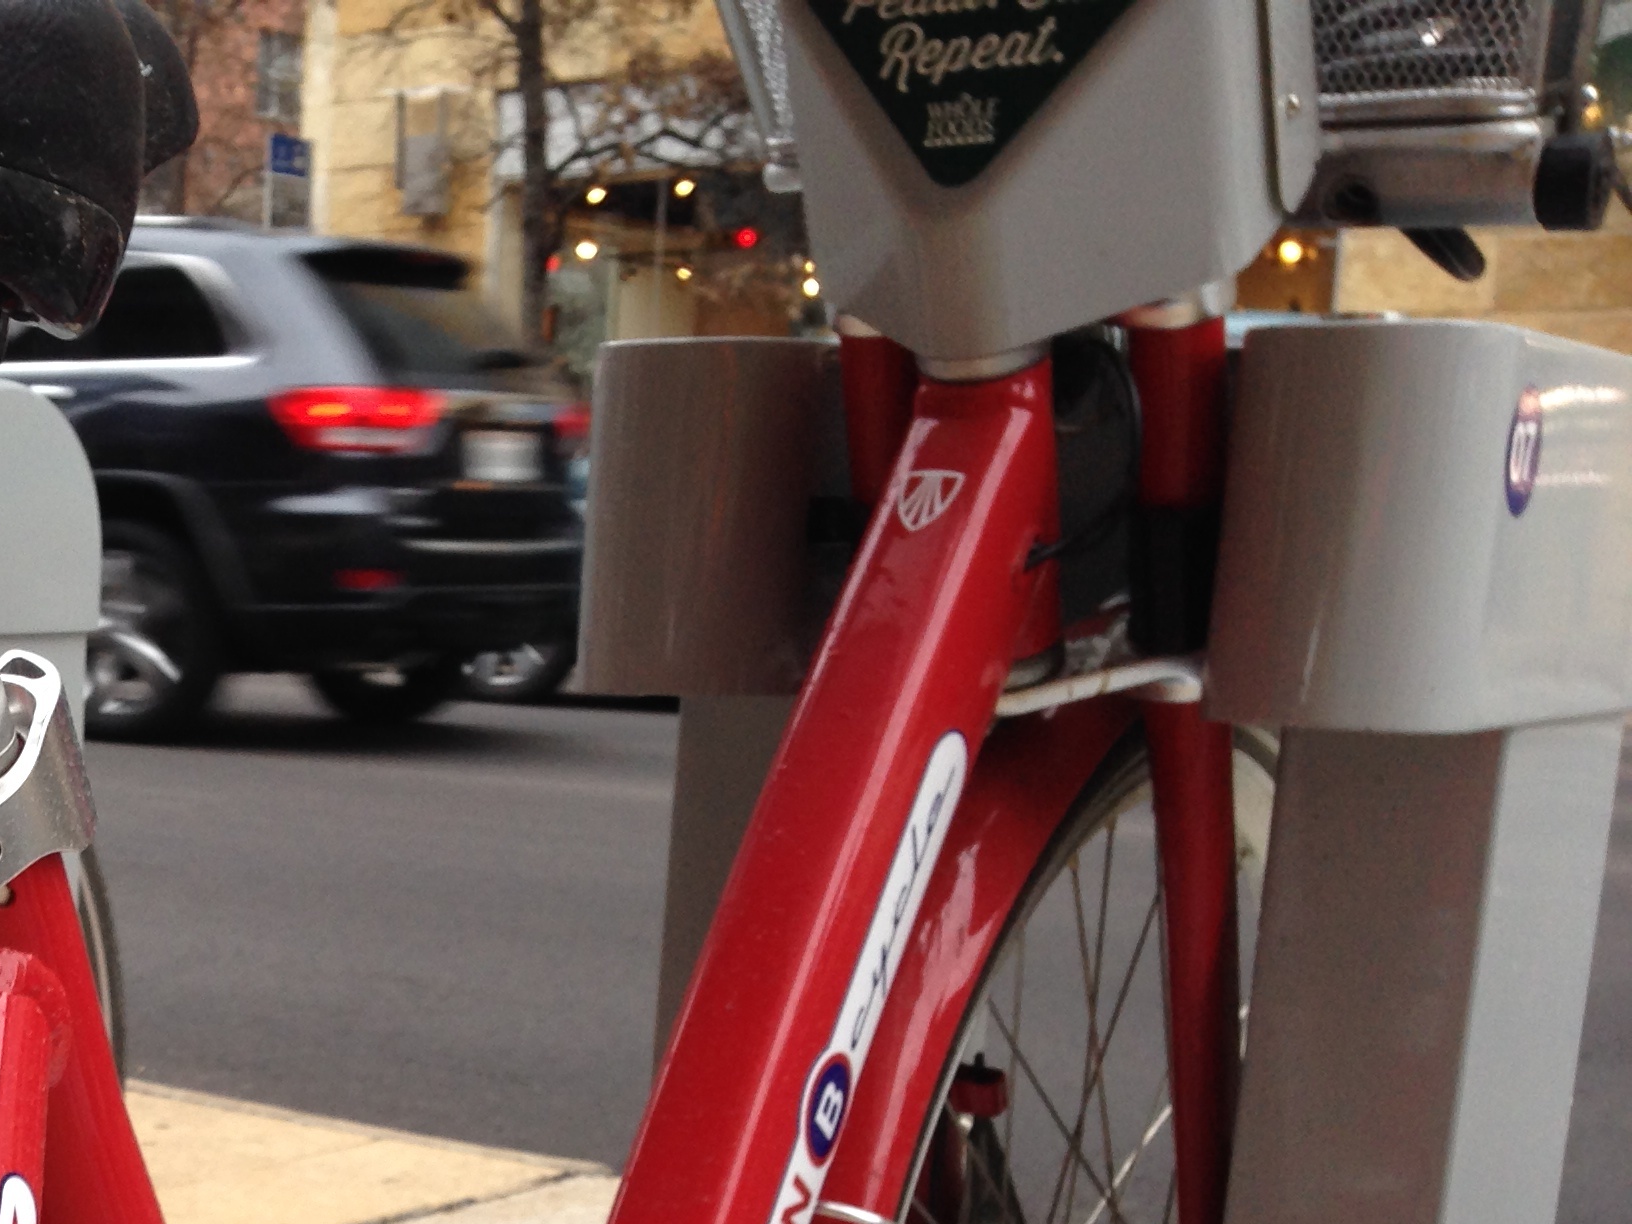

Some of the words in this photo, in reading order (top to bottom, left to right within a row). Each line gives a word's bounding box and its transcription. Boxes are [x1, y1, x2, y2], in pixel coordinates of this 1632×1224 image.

[878, 16, 1065, 94] Repeat.
[1509, 419, 1538, 484] 07
[813, 1080, 845, 1141] B
